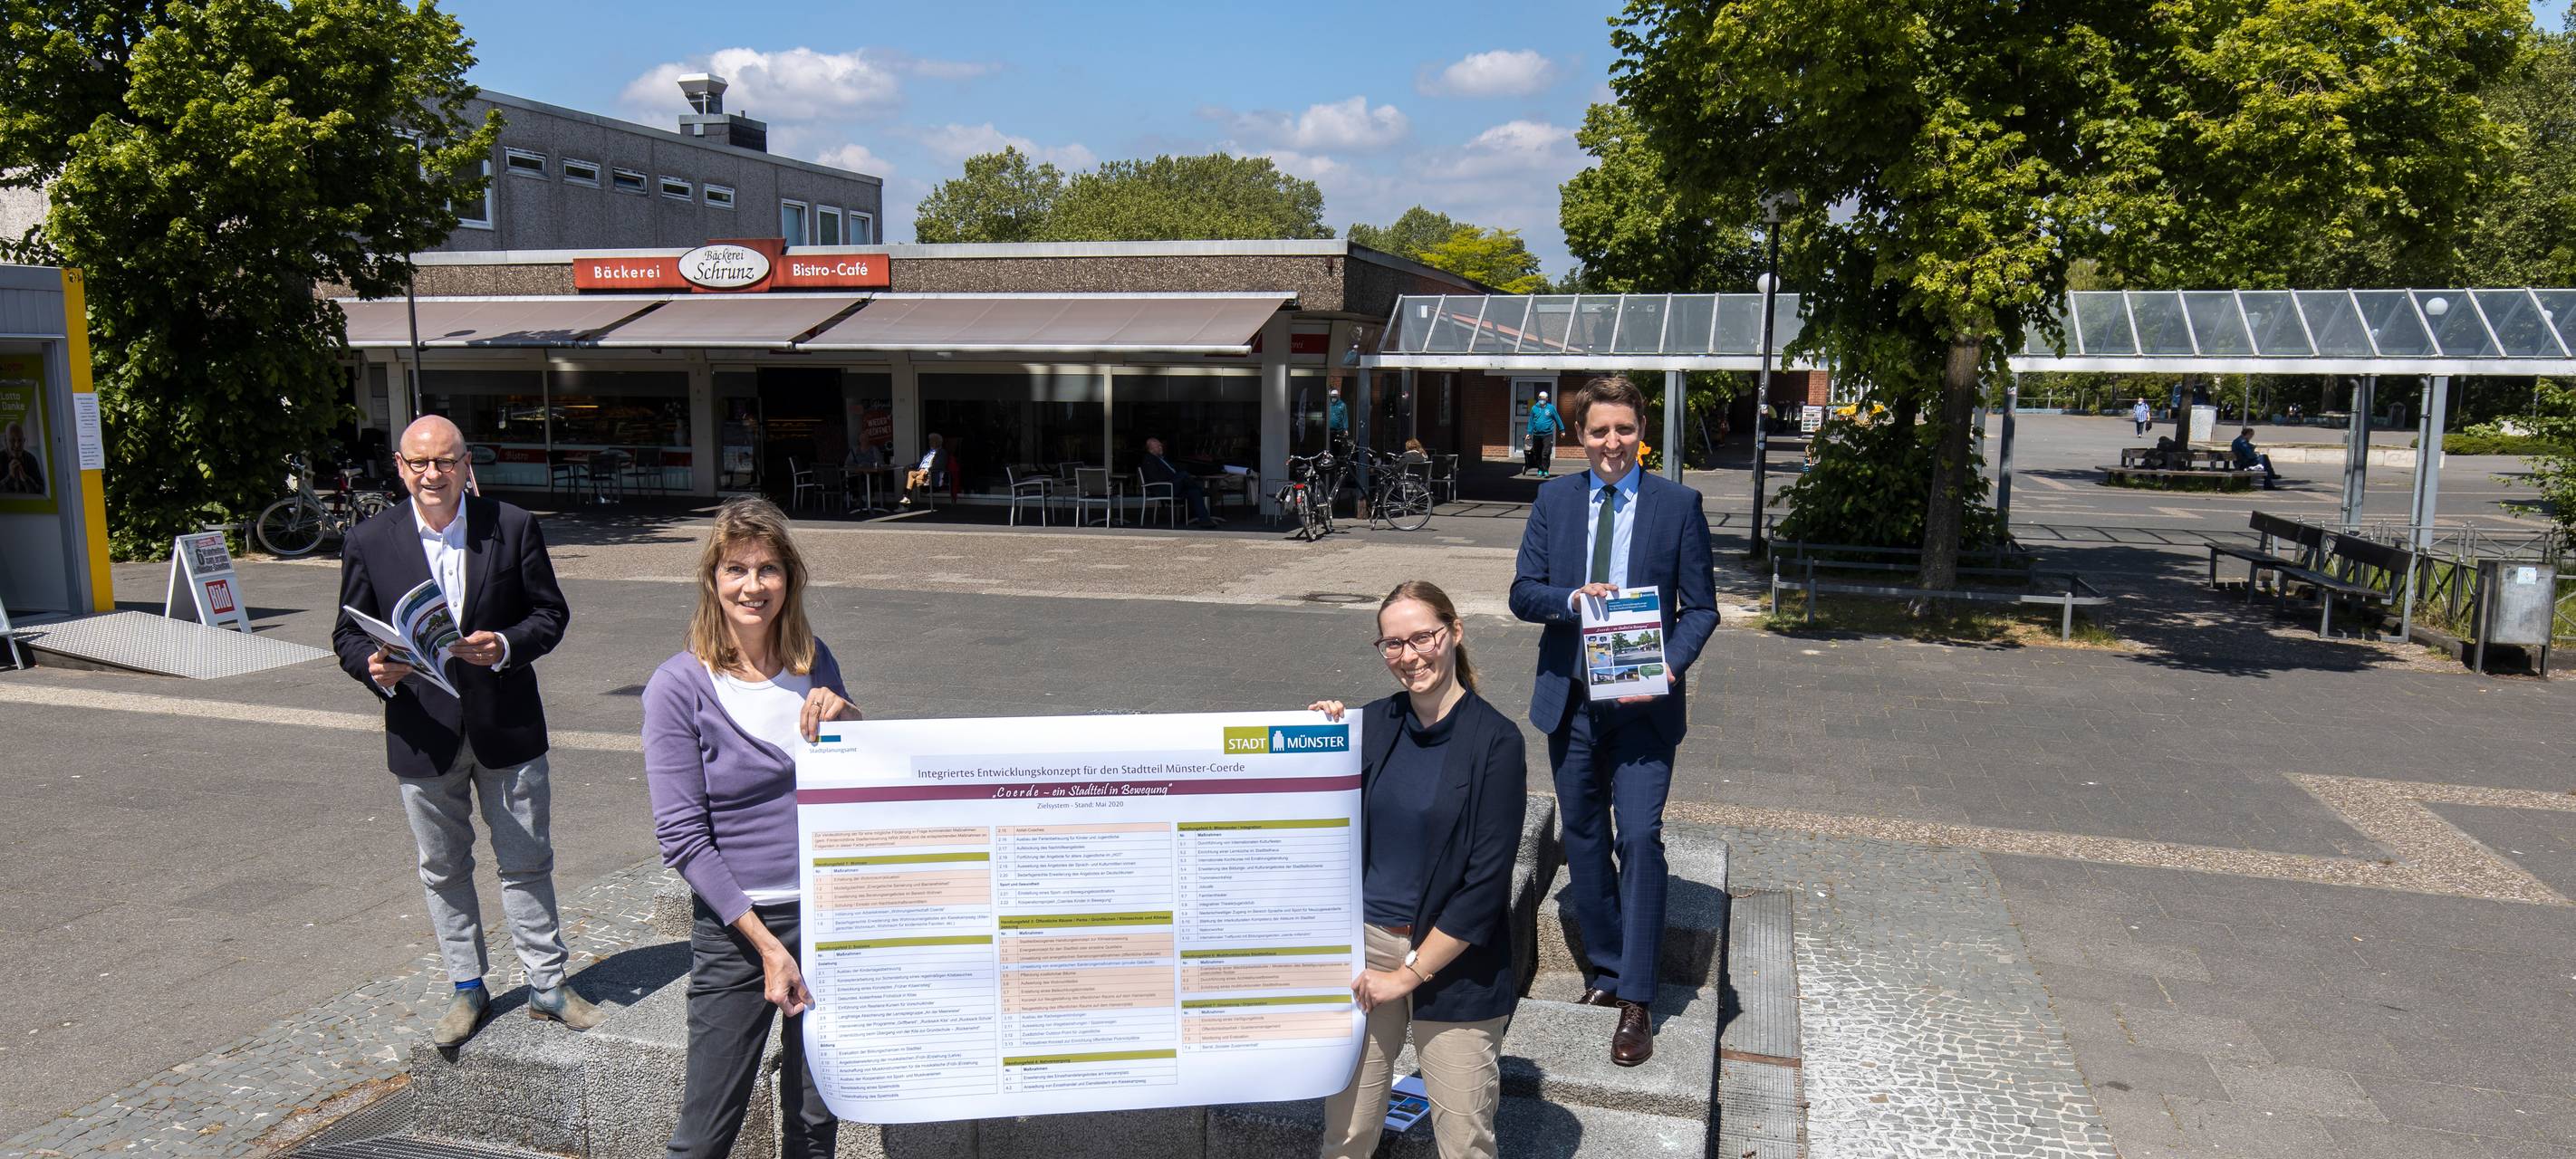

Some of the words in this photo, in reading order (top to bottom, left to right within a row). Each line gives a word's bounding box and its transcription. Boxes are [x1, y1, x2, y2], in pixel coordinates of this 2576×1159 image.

[704, 249, 745, 263] Bäckerei
[594, 265, 661, 279] Bäckerei
[693, 262, 755, 282] Schrunz
[792, 262, 868, 277] Bistro-Café
[195, 548, 205, 565] 6
[208, 584, 232, 610] Bild
[1228, 738, 1266, 750] STADT
[1287, 735, 1345, 748] MÜNSTER
[918, 769, 975, 780] Integriertes
[978, 766, 1080, 779] Entwicklungskonzept
[1084, 765, 1097, 775] für
[1100, 765, 1118, 774] den
[1121, 764, 1163, 774] Stadtteil
[1166, 762, 1245, 773] Münster-Coerde
[1052, 785, 1066, 796] ein
[1068, 783, 1109, 796] Stadtteil
[1109, 785, 1118, 795] in
